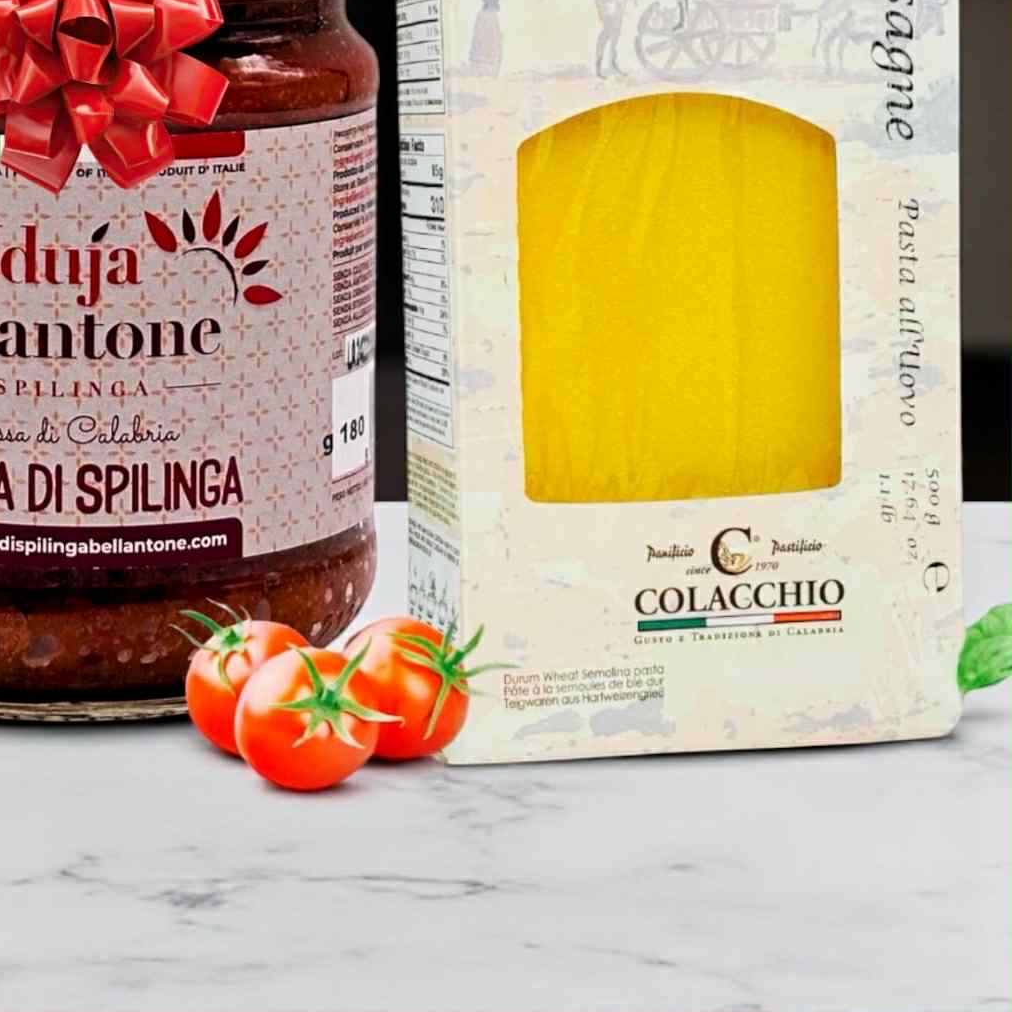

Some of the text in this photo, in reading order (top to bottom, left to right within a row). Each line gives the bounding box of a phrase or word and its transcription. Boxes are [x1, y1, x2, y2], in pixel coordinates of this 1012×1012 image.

[76, 168, 93, 178] OF
[213, 162, 246, 173] ITALIE
[898, 198, 920, 285] Pasta
[36, 416, 60, 444] di
[66, 414, 182, 445] Calabria
[322, 414, 365, 456] g 180
[27, 462, 63, 514] DI
[75, 455, 244, 515] SPILINGA
[925, 467, 940, 507] 500
[646, 544, 695, 563] Panificio
[771, 537, 824, 556] Pastificio
[754, 560, 780, 571] 1970
[634, 578, 846, 616] COLACCHIO
[503, 664, 665, 686] Durum Wheat Semolina pasta
[503, 697, 560, 711] Teigwaren
[561, 694, 581, 706] aus
[544, 684, 554, 695] la
